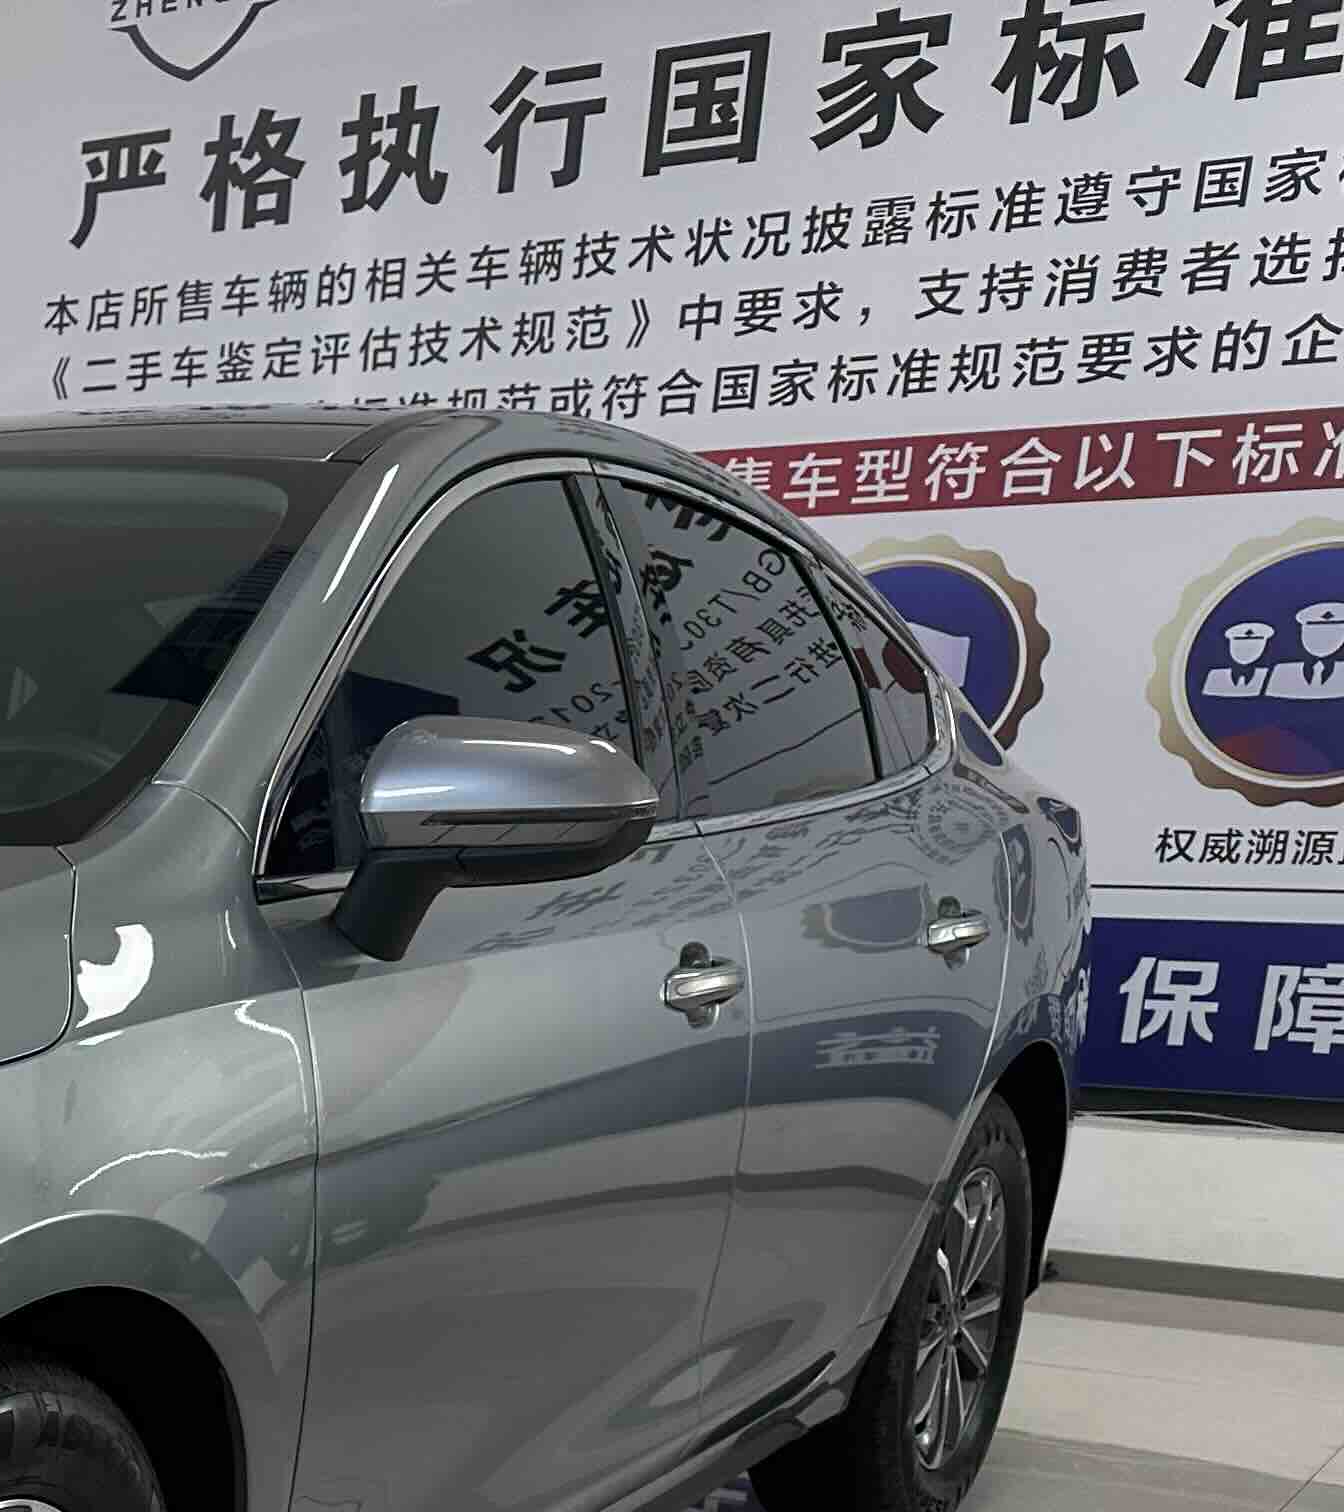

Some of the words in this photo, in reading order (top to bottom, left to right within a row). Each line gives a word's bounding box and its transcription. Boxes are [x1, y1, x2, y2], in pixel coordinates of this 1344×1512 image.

[69, 0, 1343, 249] 严格执行国家标准
[44, 147, 1344, 335] 本店所售车辆的相关车辆技术状况披露标准遵守国家
[1155, 828, 1344, 867] 权威溯源
[1119, 956, 1344, 1054] 保障
